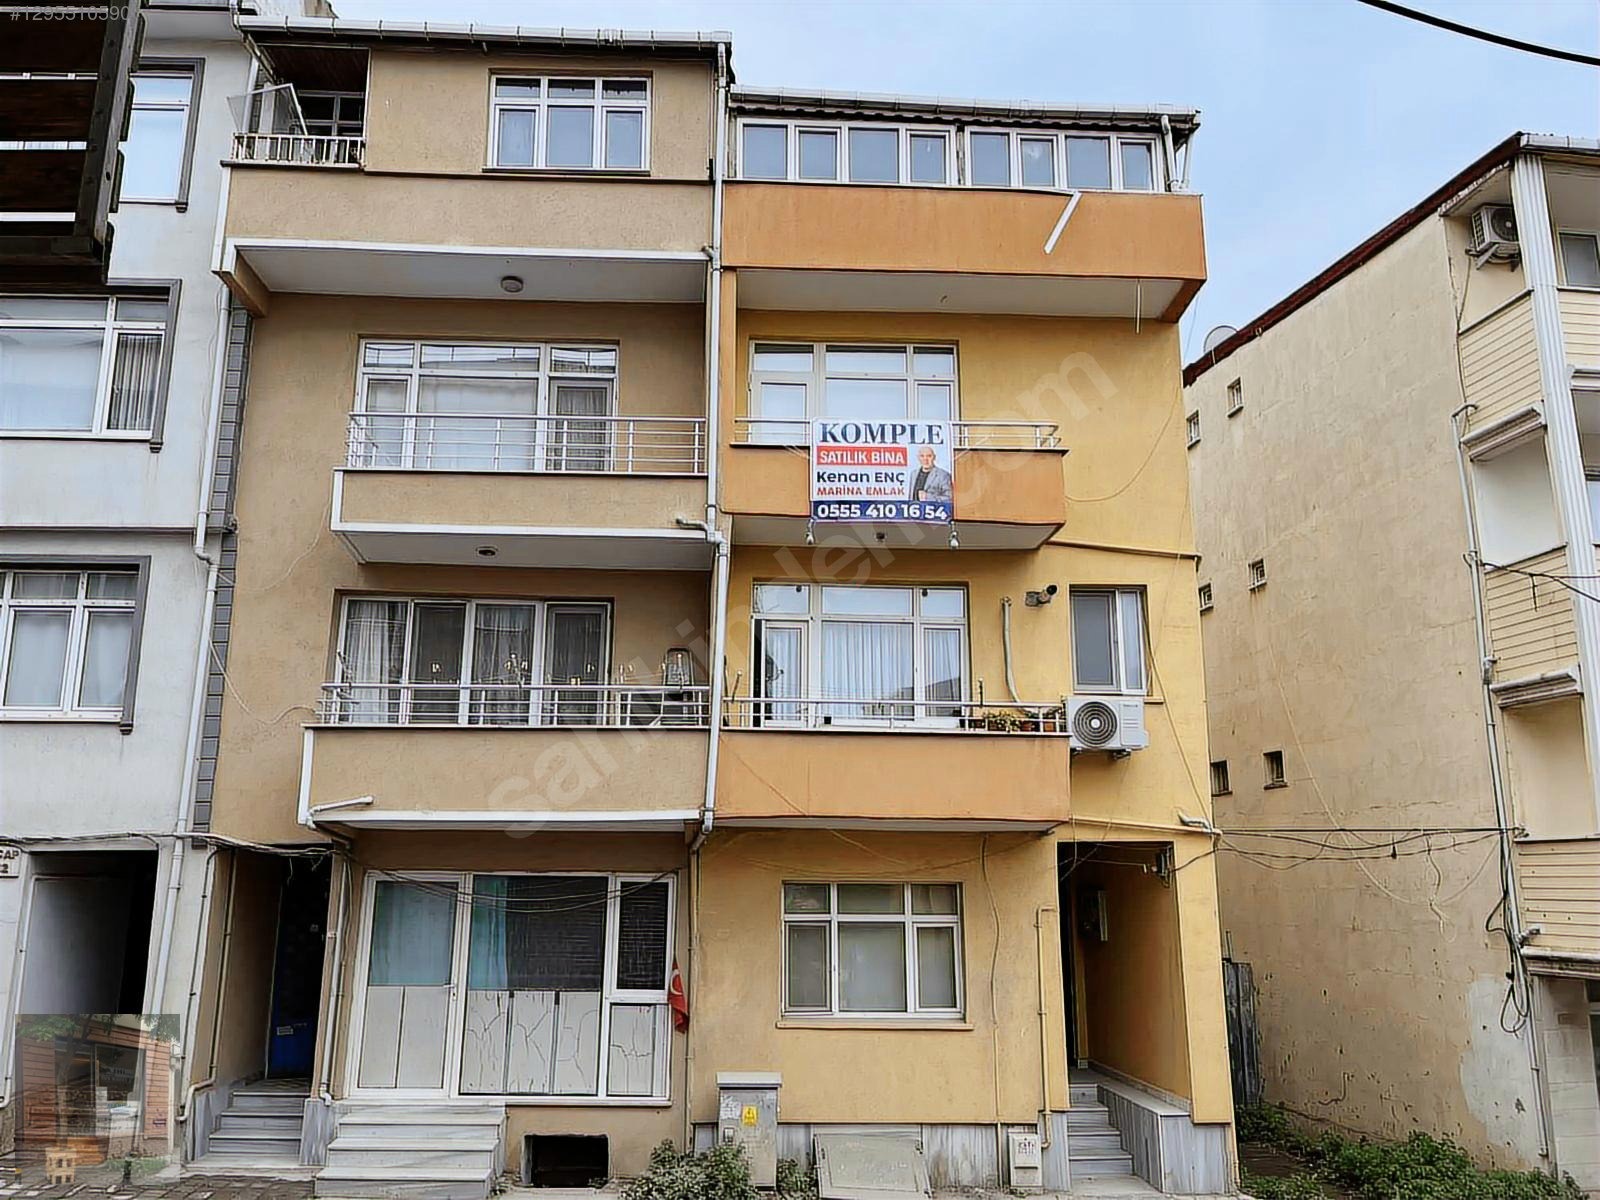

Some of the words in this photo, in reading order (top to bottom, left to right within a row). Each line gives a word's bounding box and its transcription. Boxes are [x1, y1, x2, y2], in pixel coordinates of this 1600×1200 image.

[820, 422, 944, 445] KOMPLE
[820, 451, 868, 463] SATILIK
[871, 449, 905, 464] BİNA
[817, 471, 869, 483] Kenan
[875, 472, 905, 486] ENÇ
[817, 486, 863, 496] MARİNA
[866, 486, 905, 496] EMLAK
[817, 504, 861, 518] 0555
[865, 504, 897, 518] 410
[901, 504, 920, 518] 16
[924, 505, 948, 520] 54
